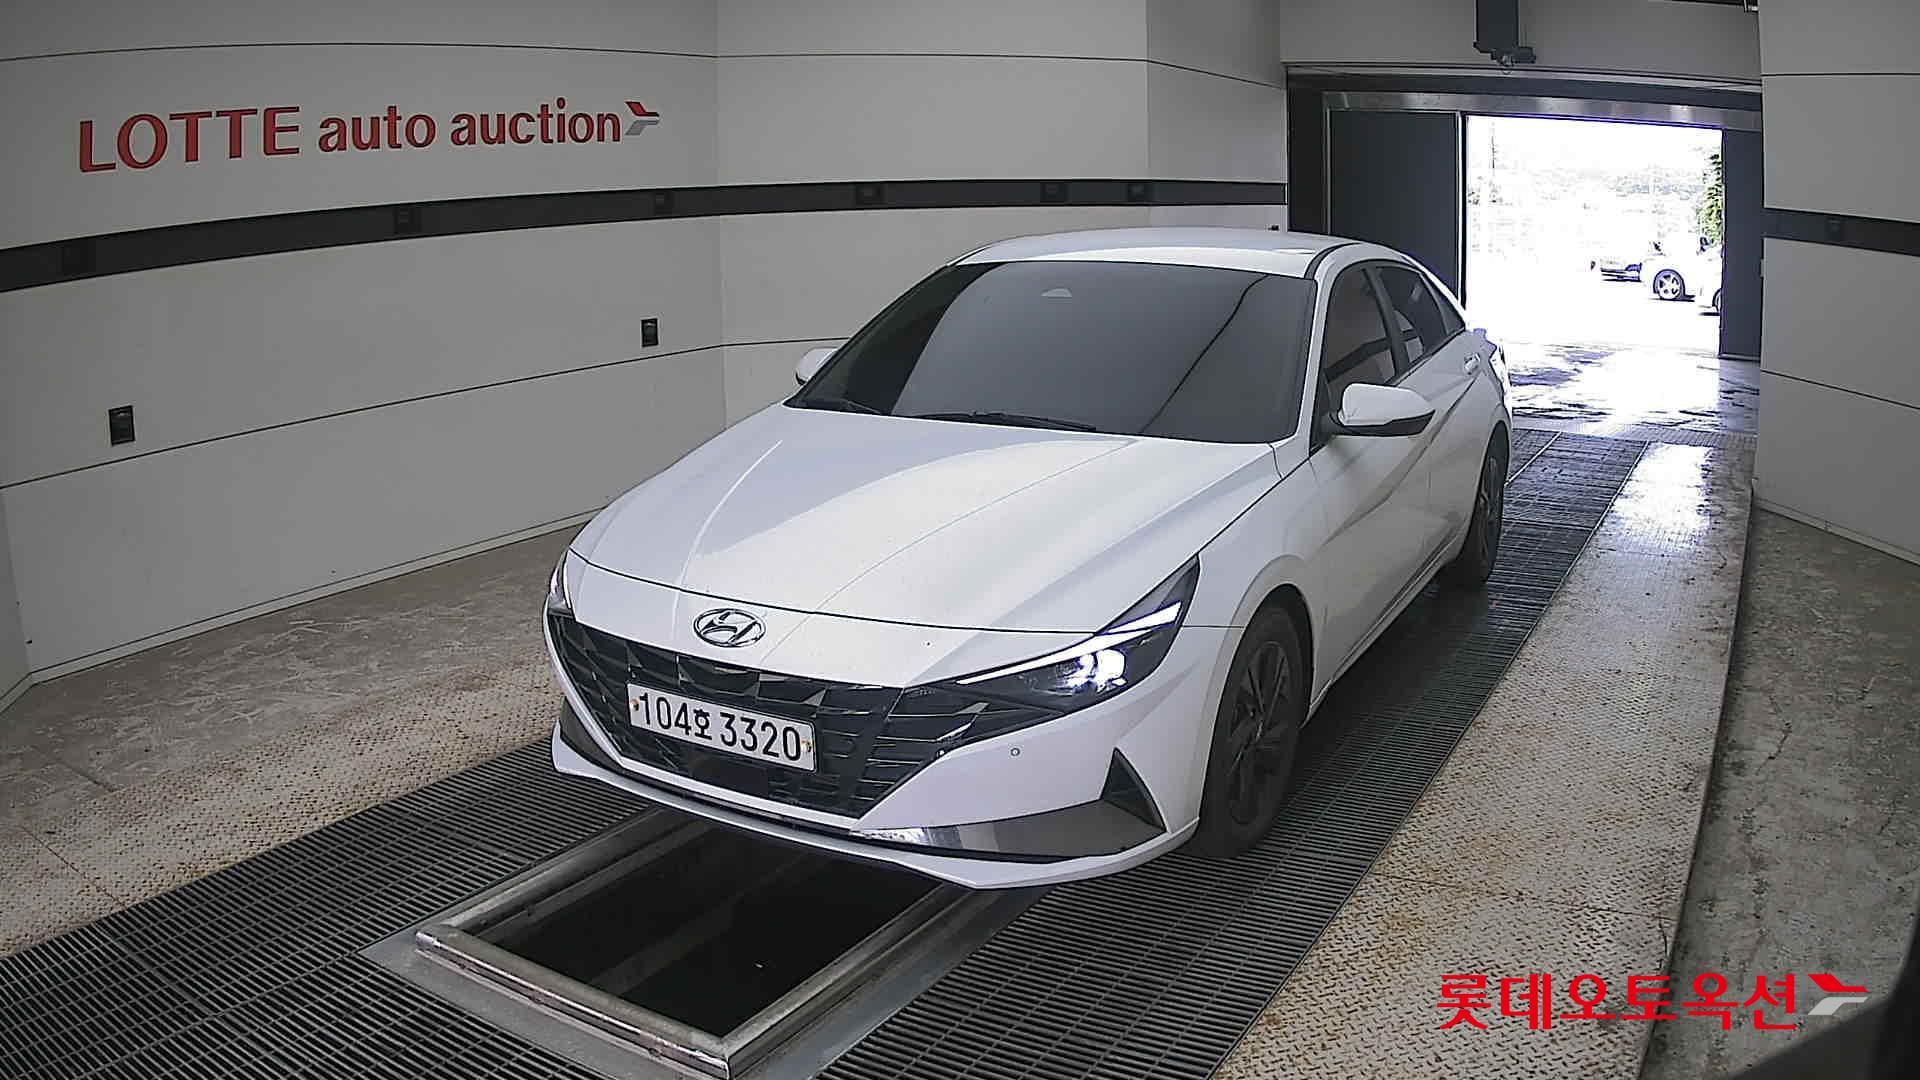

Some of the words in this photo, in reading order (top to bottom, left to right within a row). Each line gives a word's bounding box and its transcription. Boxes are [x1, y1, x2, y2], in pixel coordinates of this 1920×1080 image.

[79, 105, 301, 173] LOTTE
[318, 105, 436, 153] auto
[450, 97, 622, 146] auction
[639, 692, 713, 741] 104호
[719, 712, 802, 762] 3320
